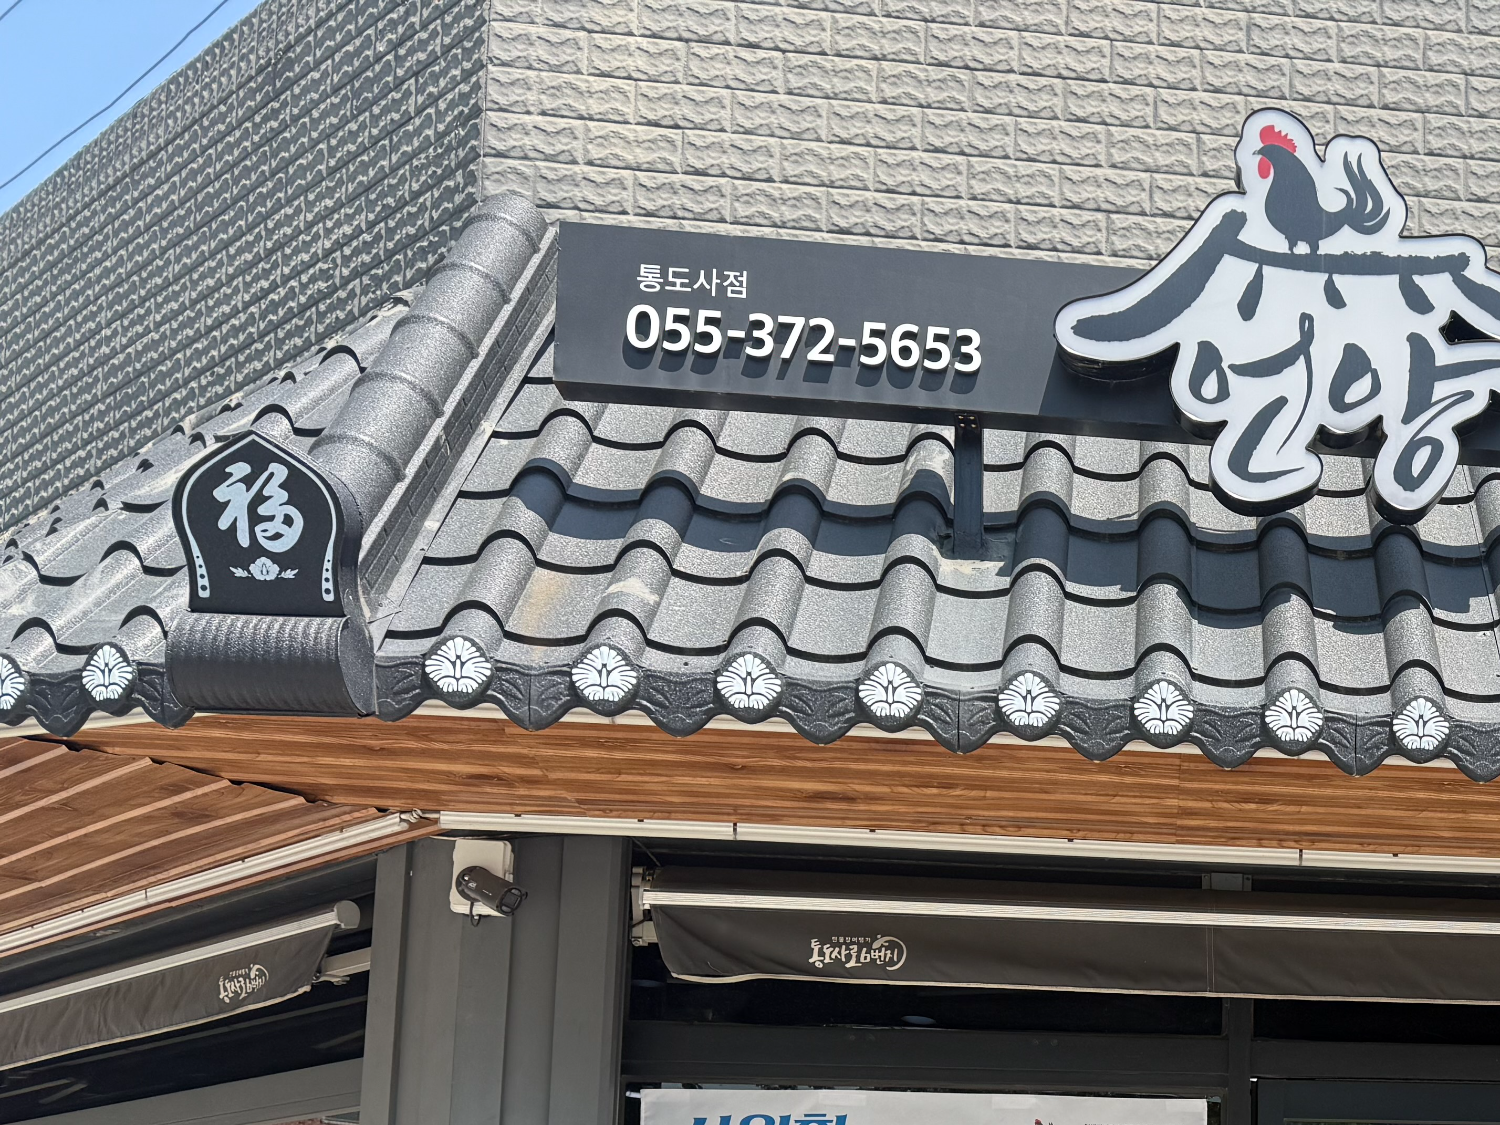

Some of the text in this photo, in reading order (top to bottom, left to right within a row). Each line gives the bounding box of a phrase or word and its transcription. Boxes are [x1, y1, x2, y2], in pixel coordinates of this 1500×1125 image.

[636, 263, 748, 298] 통도사점
[625, 303, 982, 374] 055-372-5653
[212, 461, 304, 553] 福
